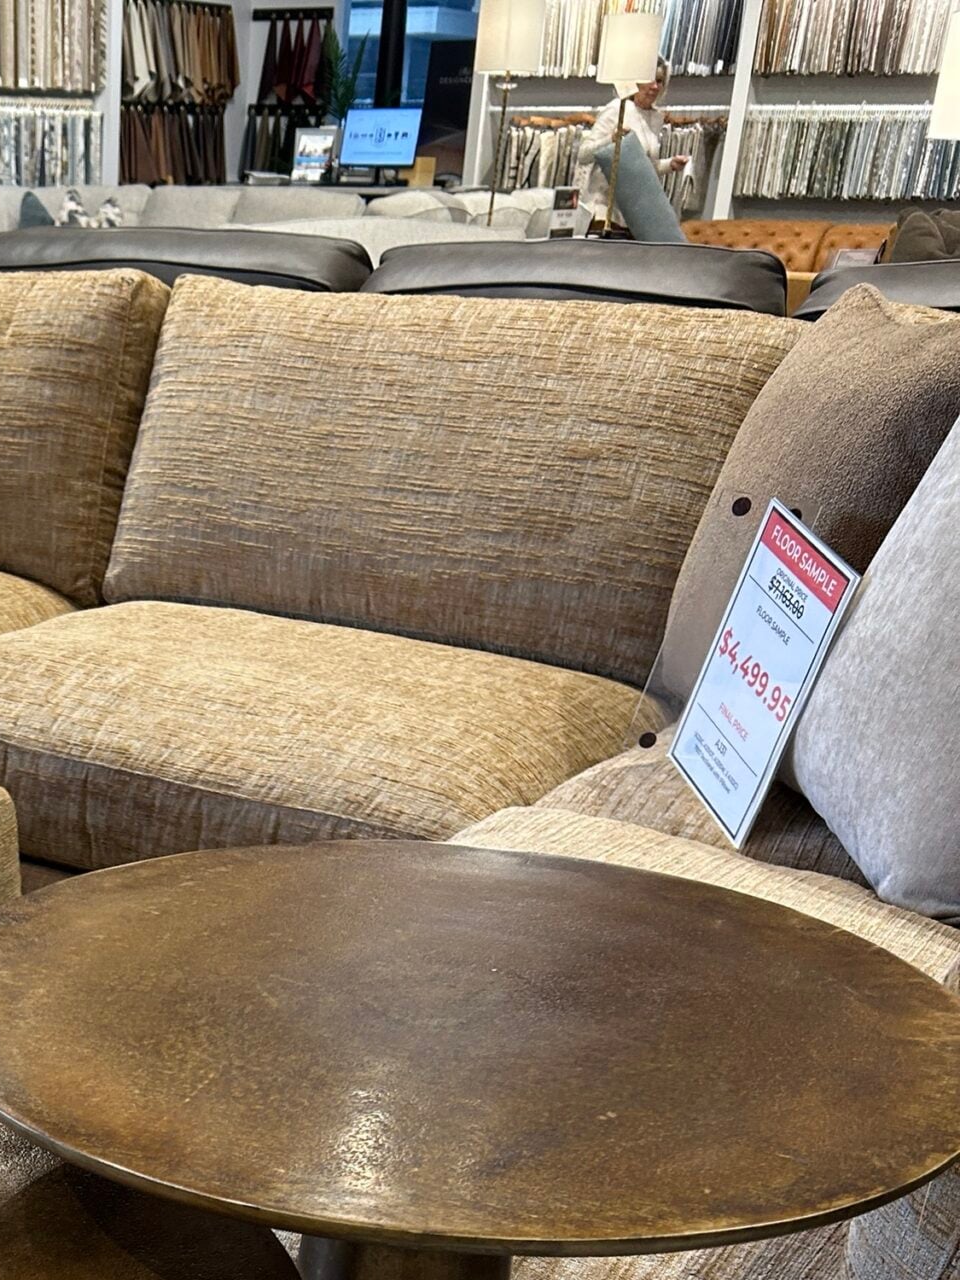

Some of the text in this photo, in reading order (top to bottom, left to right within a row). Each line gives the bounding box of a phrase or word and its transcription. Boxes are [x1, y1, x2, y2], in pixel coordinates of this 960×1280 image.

[771, 525, 837, 597] FLOOR SAMPLE
[794, 585, 808, 603] PRICE
[756, 605, 791, 646] FLOOR SAMPLE
[718, 627, 792, 722] $4,499.95
